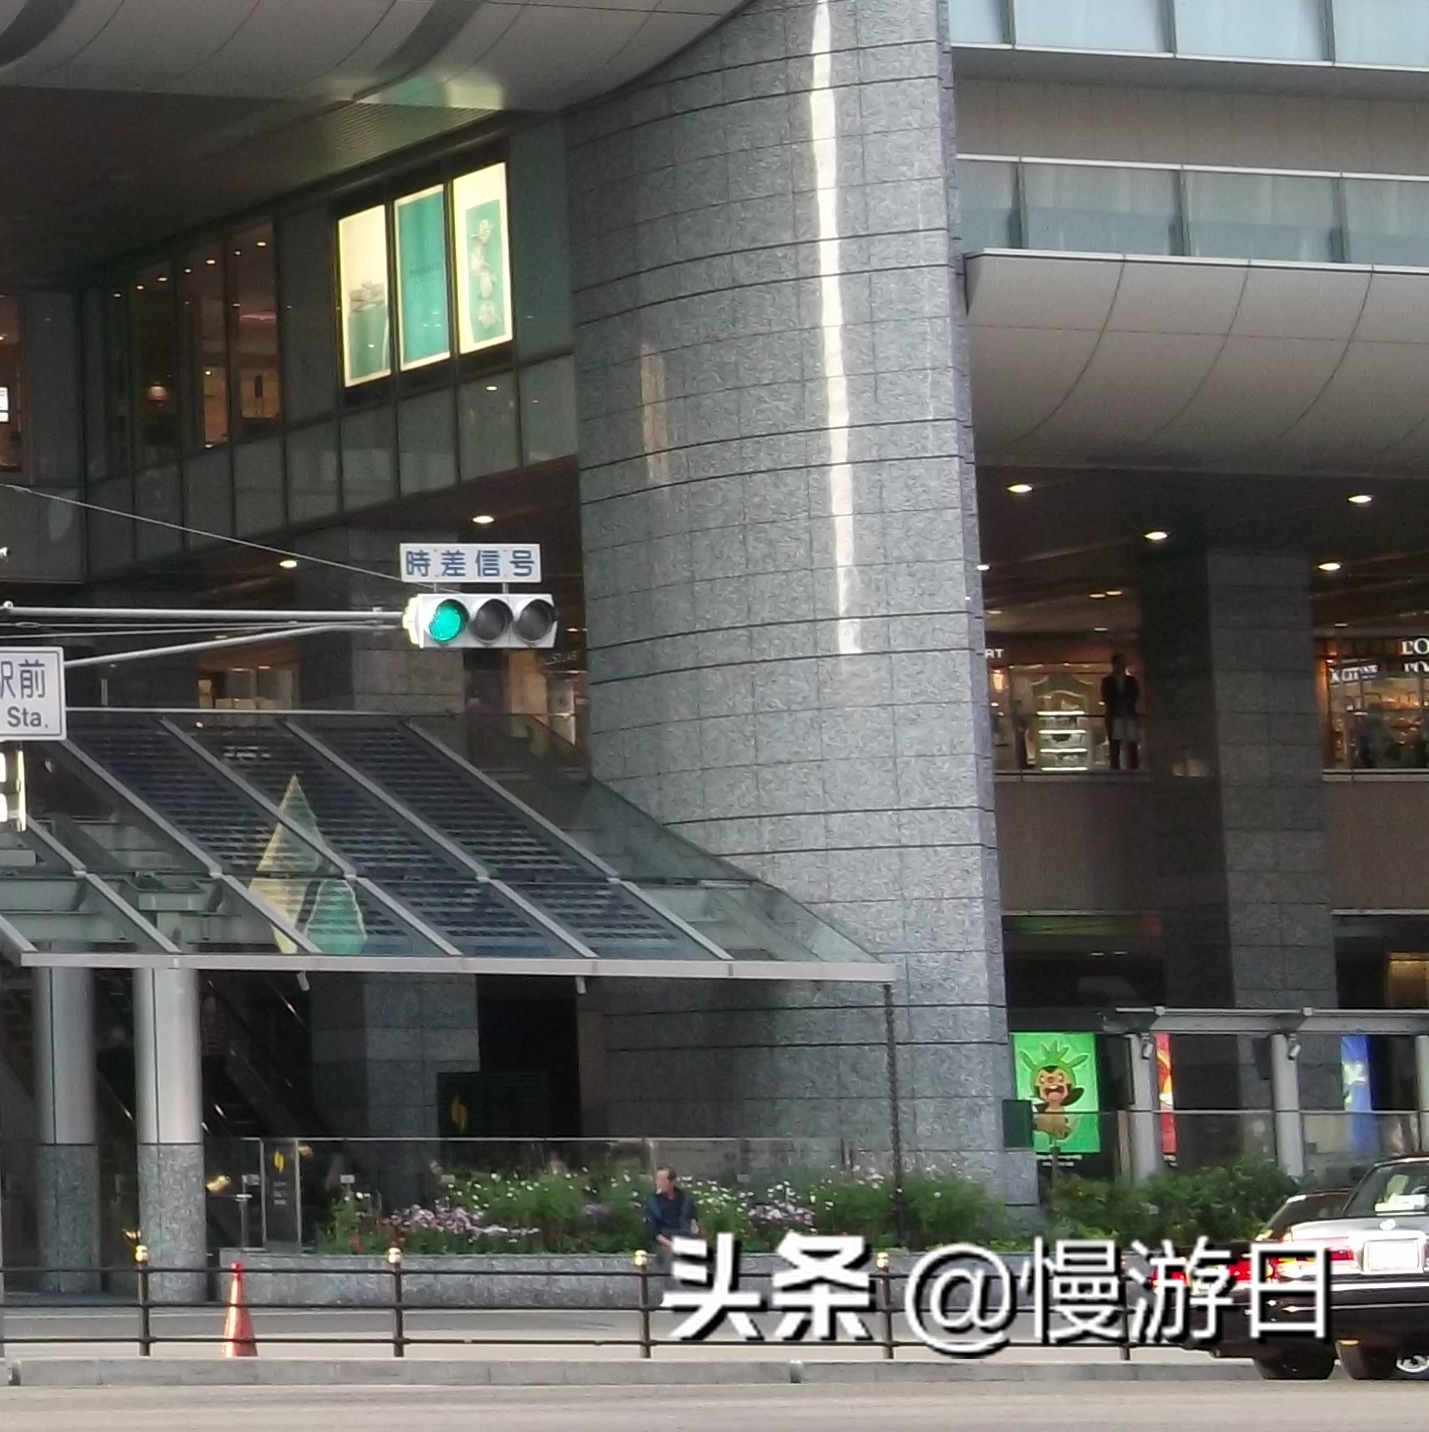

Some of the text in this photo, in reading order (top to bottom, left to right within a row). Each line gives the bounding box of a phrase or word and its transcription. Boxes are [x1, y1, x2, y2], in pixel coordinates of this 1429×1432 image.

[406, 549, 535, 577] 時差信号
[7, 706, 49, 728] Sta.
